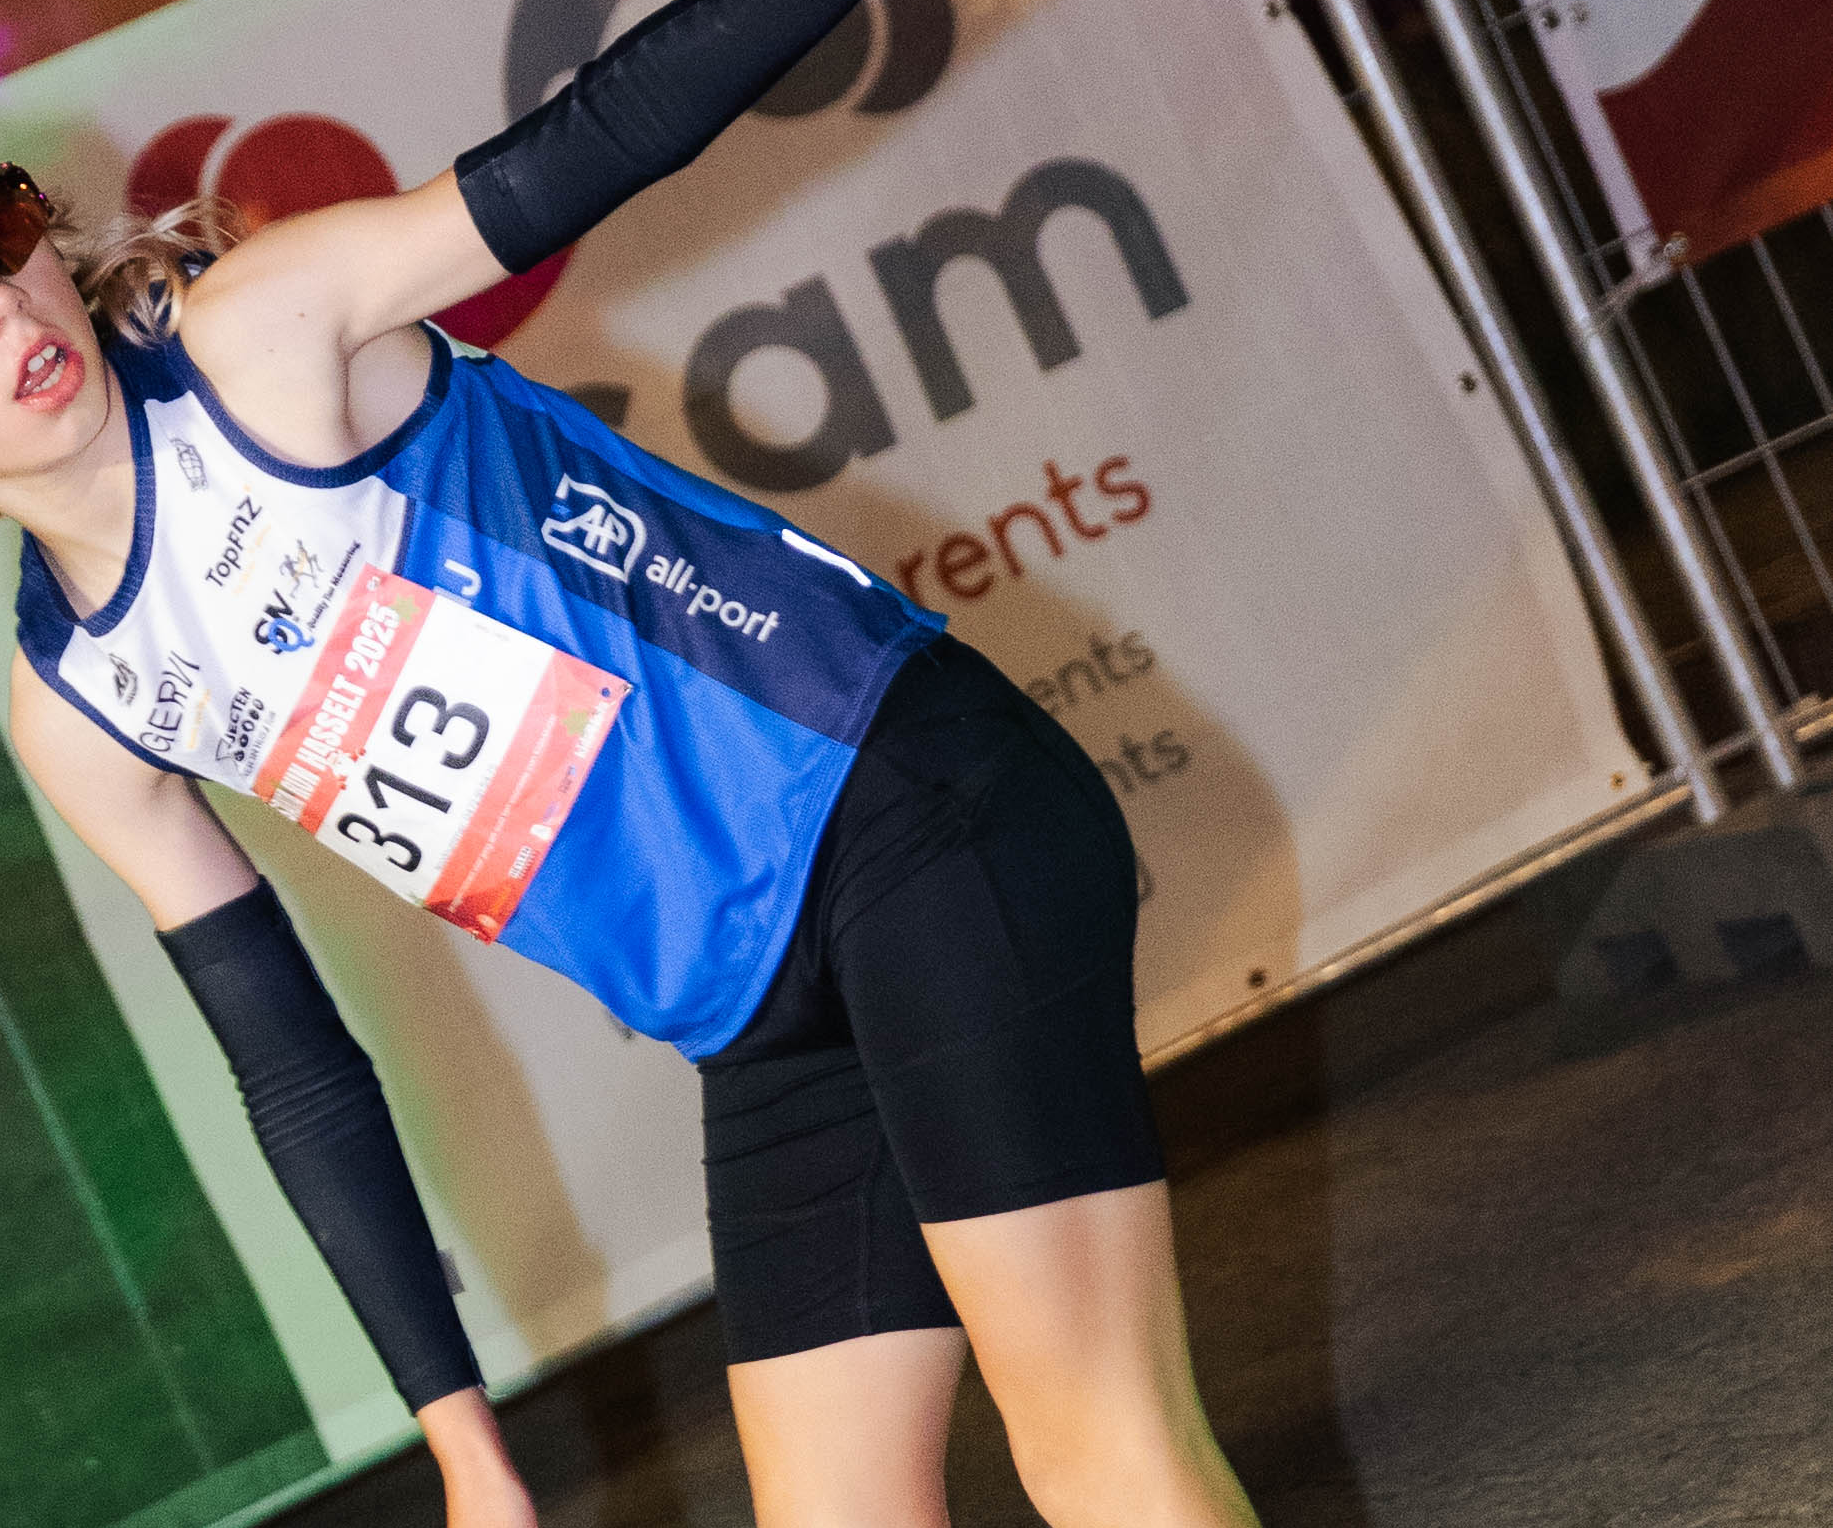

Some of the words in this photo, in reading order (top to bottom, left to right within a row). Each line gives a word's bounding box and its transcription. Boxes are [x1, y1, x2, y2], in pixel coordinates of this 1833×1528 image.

[569, 155, 1190, 494] am
[205, 495, 264, 588] TopFnZ
[896, 454, 1152, 606] rents
[645, 553, 782, 643] all-port
[140, 650, 201, 753] GERVI
[223, 685, 253, 750] JECTEN
[295, 673, 369, 771] HASSELT
[344, 600, 401, 680] 2025
[335, 683, 491, 875] 313
